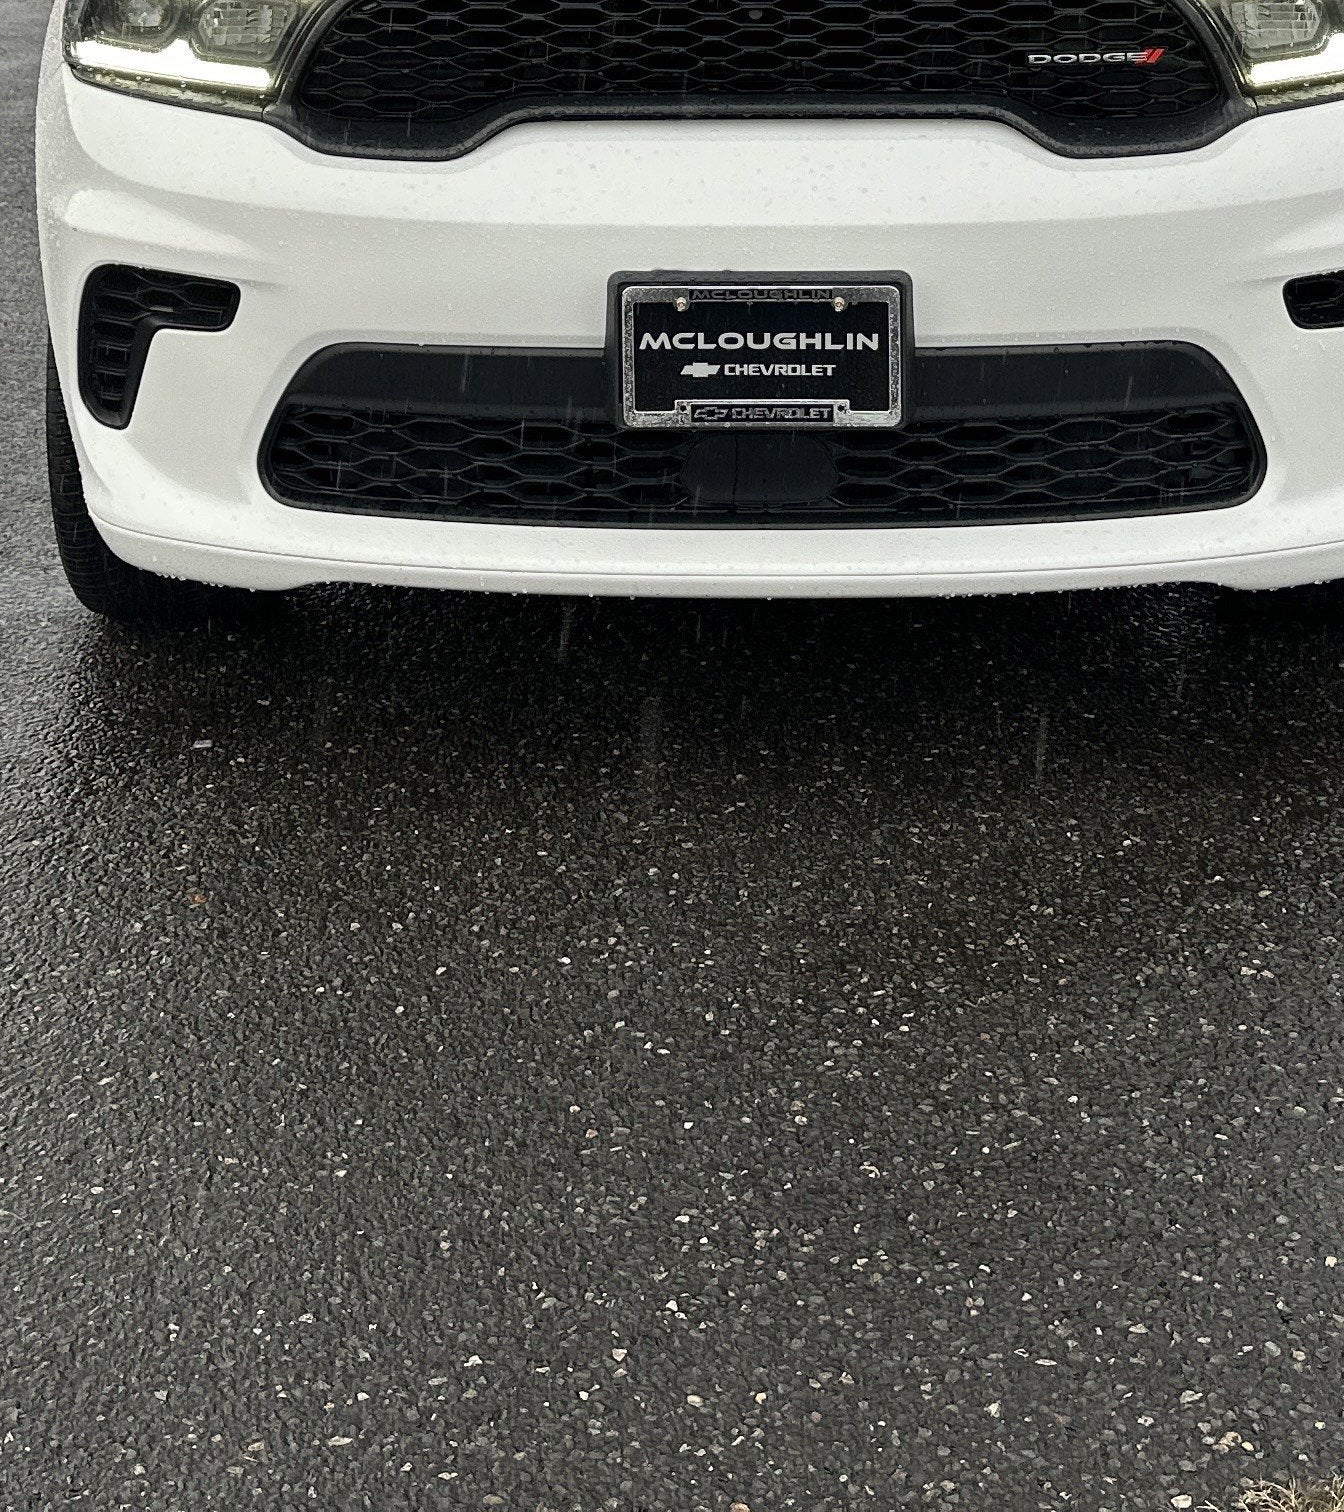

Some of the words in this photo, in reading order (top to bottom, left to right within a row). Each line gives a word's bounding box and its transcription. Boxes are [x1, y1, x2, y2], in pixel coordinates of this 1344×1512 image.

[1027, 52, 1149, 65] DODGE
[691, 289, 833, 300] MCLOUGHLIN
[638, 332, 880, 351] MCLOUGHLIN
[724, 363, 837, 377] CHEVROLET
[731, 407, 832, 420] CHEVROLET
